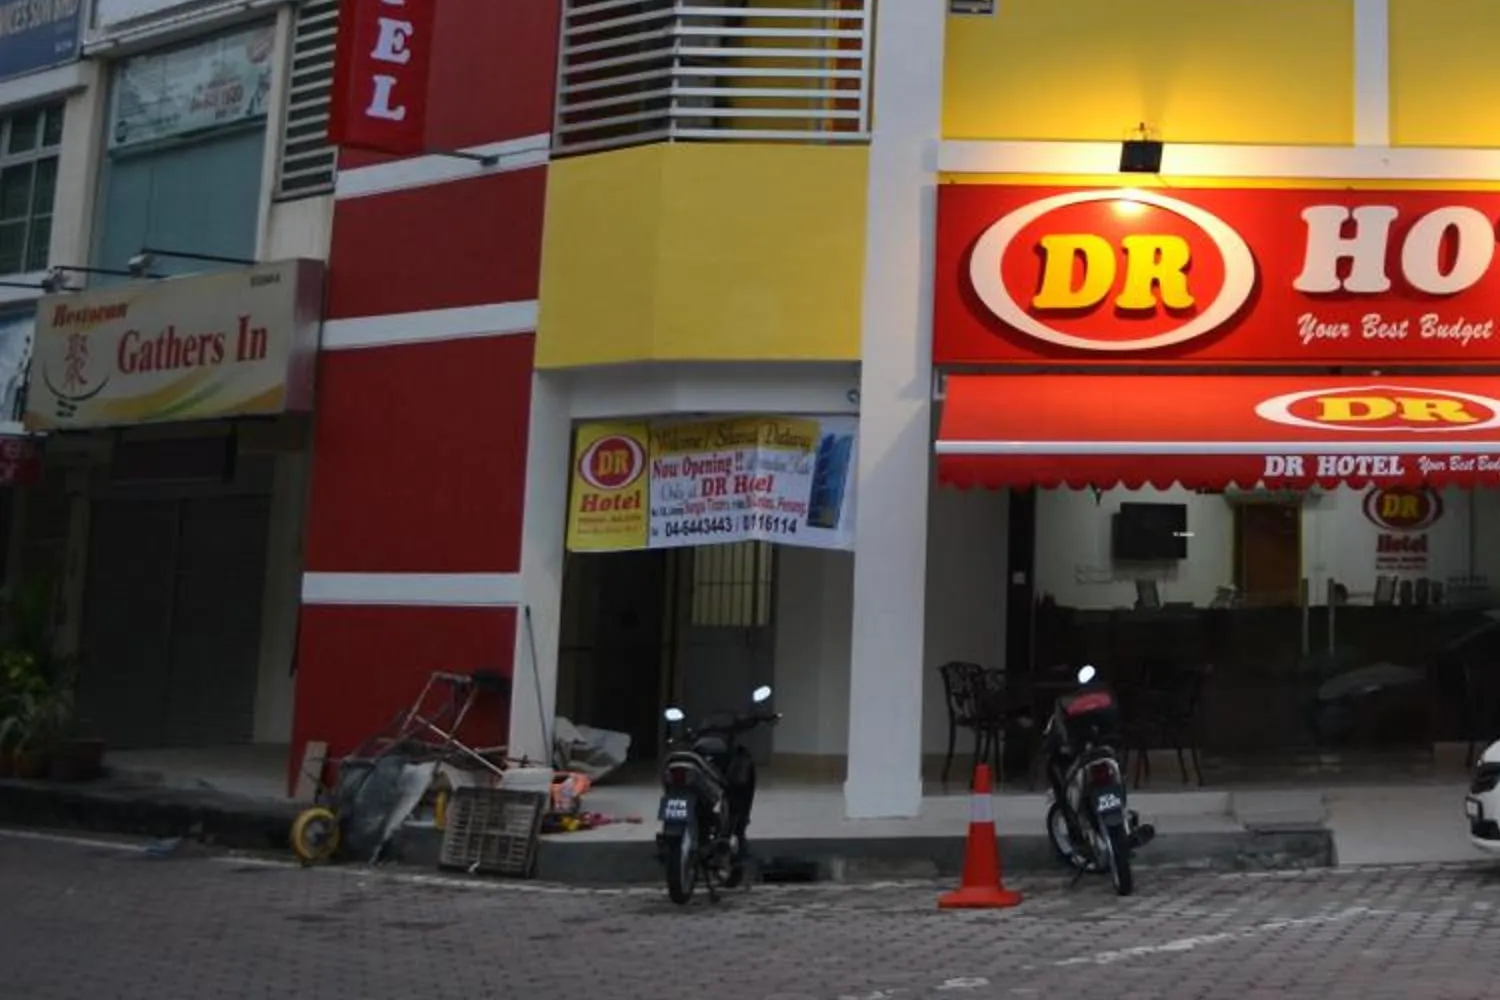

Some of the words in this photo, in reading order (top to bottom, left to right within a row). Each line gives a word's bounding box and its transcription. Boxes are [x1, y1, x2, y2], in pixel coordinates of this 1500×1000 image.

[1030, 232, 1196, 312] DR
[1297, 313, 1351, 344] Your
[1361, 313, 1409, 339] Best
[1419, 313, 1494, 344] Budget
[117, 325, 227, 374] Gathers
[236, 315, 268, 362] In
[1316, 397, 1480, 423] DR
[598, 449, 630, 476] DR
[653, 459, 678, 479] Now
[682, 453, 733, 479] Opening
[1264, 455, 1304, 476] DR
[1316, 455, 1405, 476] HOTEL
[1418, 455, 1445, 472] Your
[1449, 455, 1475, 471] Best
[580, 489, 642, 512] Hotel
[702, 477, 728, 498] DR
[1382, 493, 1420, 518] DR
